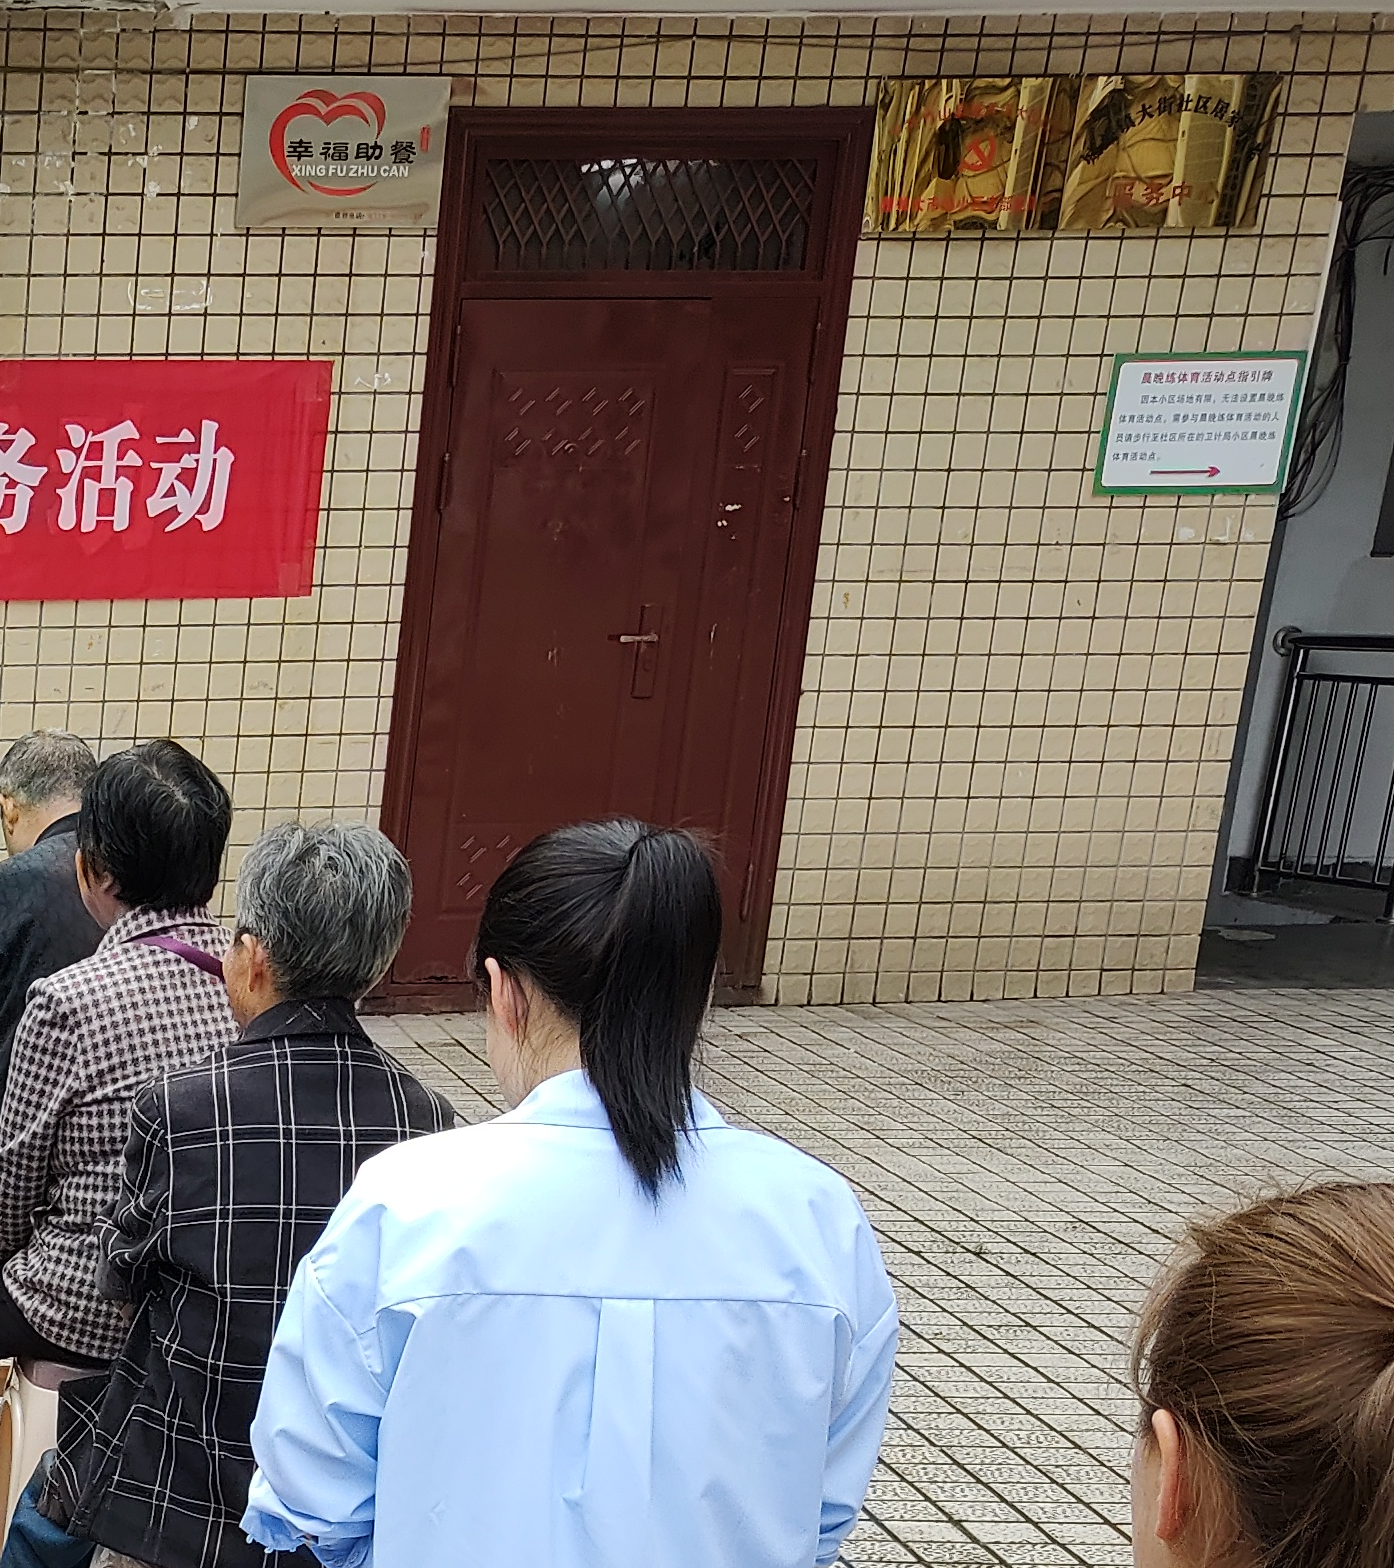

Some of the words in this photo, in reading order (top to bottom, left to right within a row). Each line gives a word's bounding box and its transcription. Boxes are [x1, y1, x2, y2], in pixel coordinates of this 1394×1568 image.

[286, 139, 417, 164] 幸福助餐
[292, 164, 326, 177] XING
[328, 164, 347, 177] FU
[348, 164, 377, 177] ZHU
[380, 165, 409, 178] CAN
[1141, 370, 1274, 384] 晨晚练体育活动点指引牌
